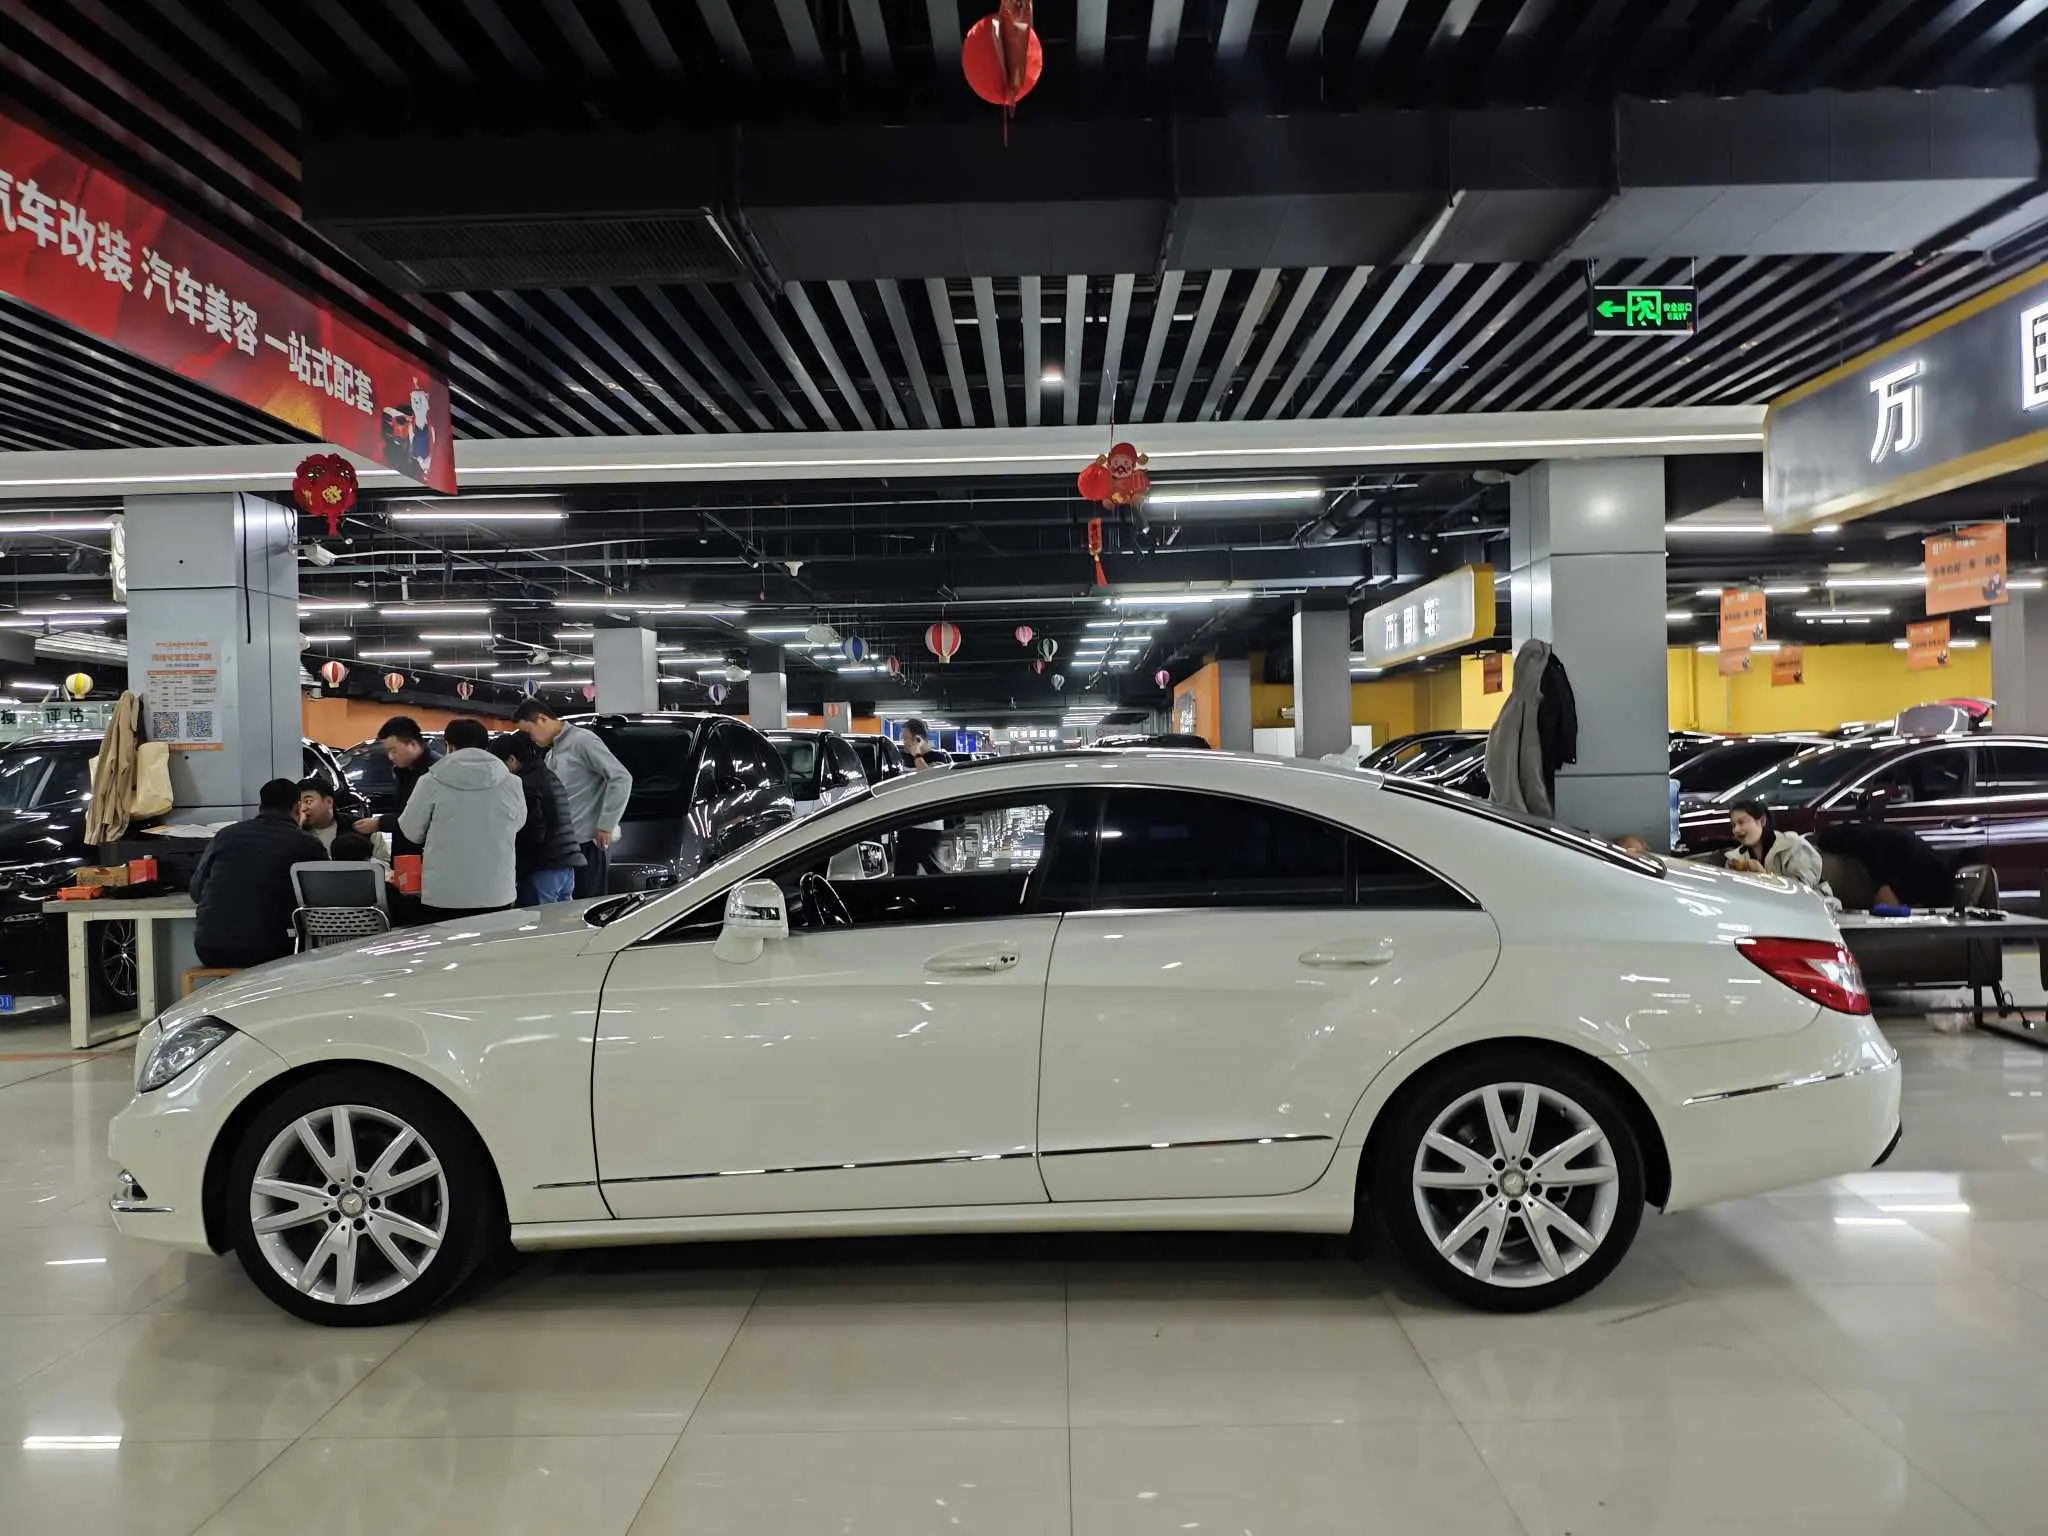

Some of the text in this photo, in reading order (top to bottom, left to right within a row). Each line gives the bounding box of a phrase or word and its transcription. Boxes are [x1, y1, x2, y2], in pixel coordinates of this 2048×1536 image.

[1667, 312, 1687, 321] EXIT
[141, 246, 259, 356] 汽车美容
[265, 331, 374, 416] 一站式配套
[46, 707, 84, 723] 评估
